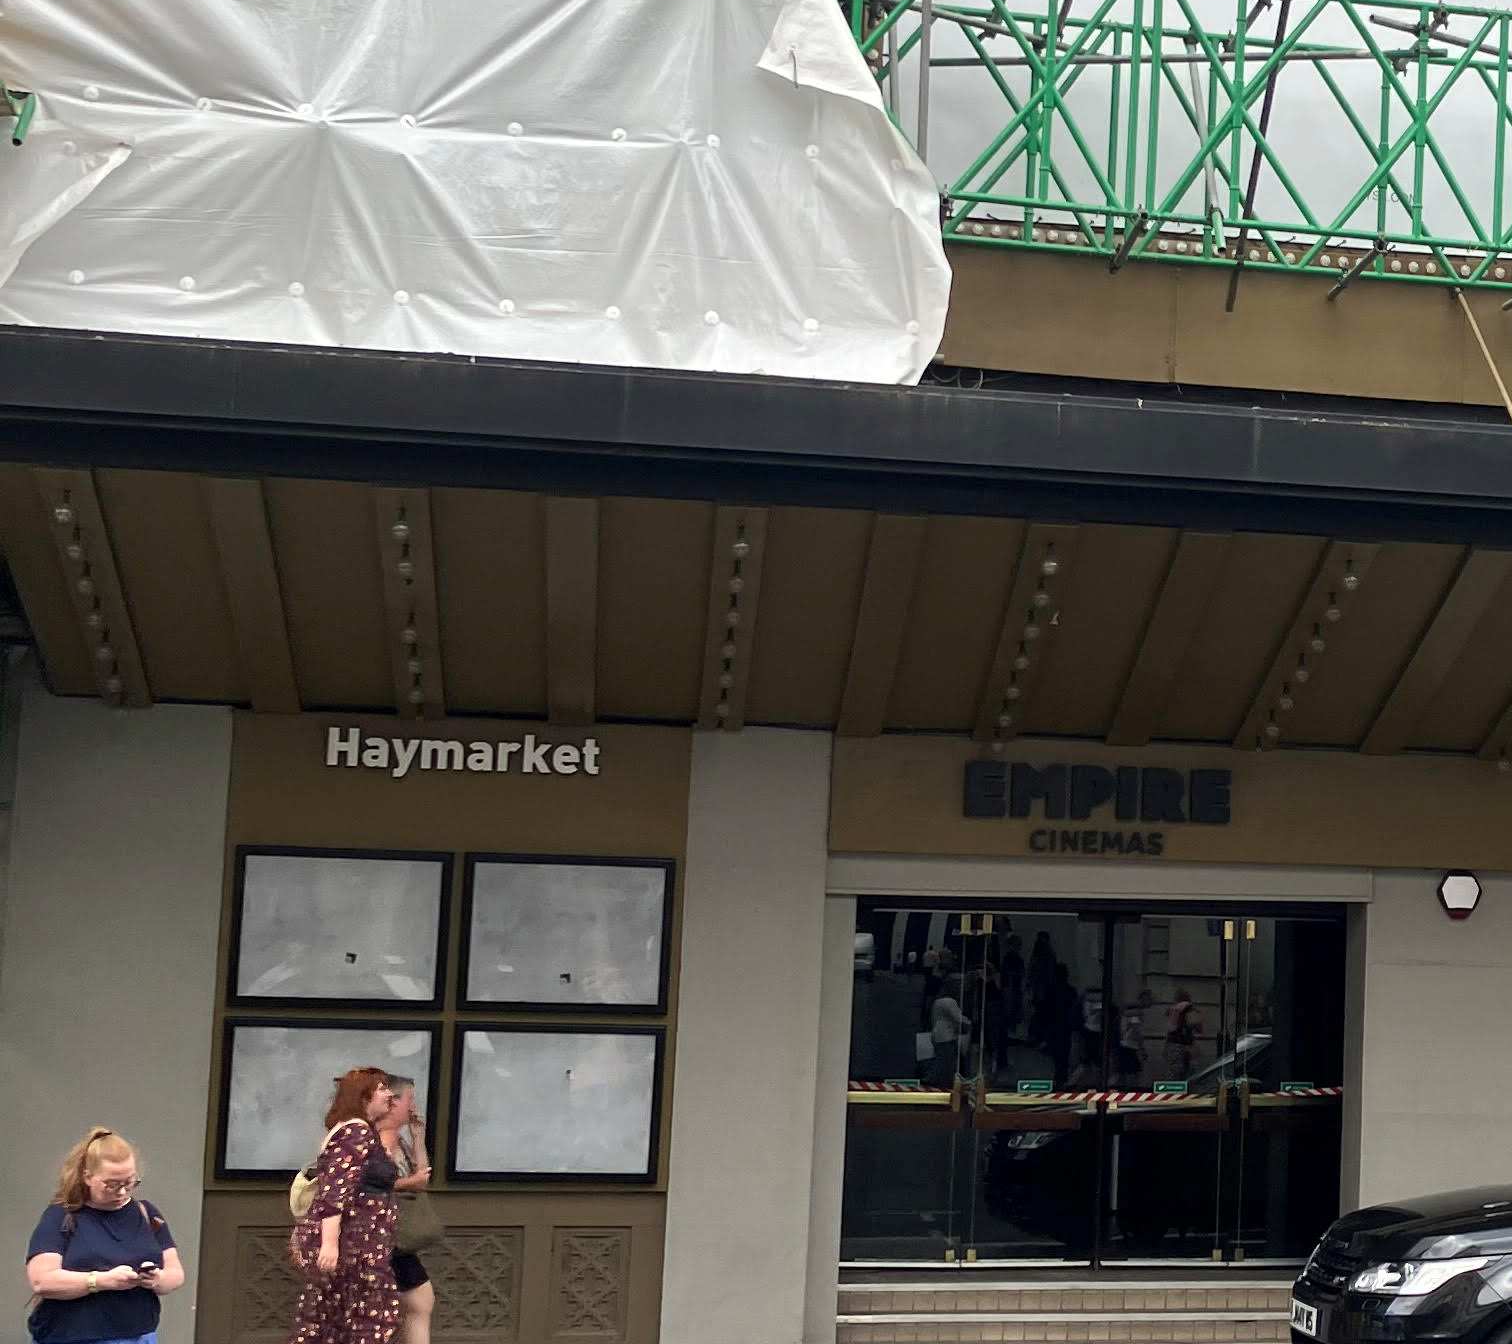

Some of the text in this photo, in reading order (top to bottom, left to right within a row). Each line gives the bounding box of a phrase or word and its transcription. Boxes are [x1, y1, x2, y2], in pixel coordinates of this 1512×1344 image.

[325, 727, 601, 778] Haymarket
[963, 760, 1232, 824] EMPIRE
[1029, 830, 1163, 856] CINEMAS
